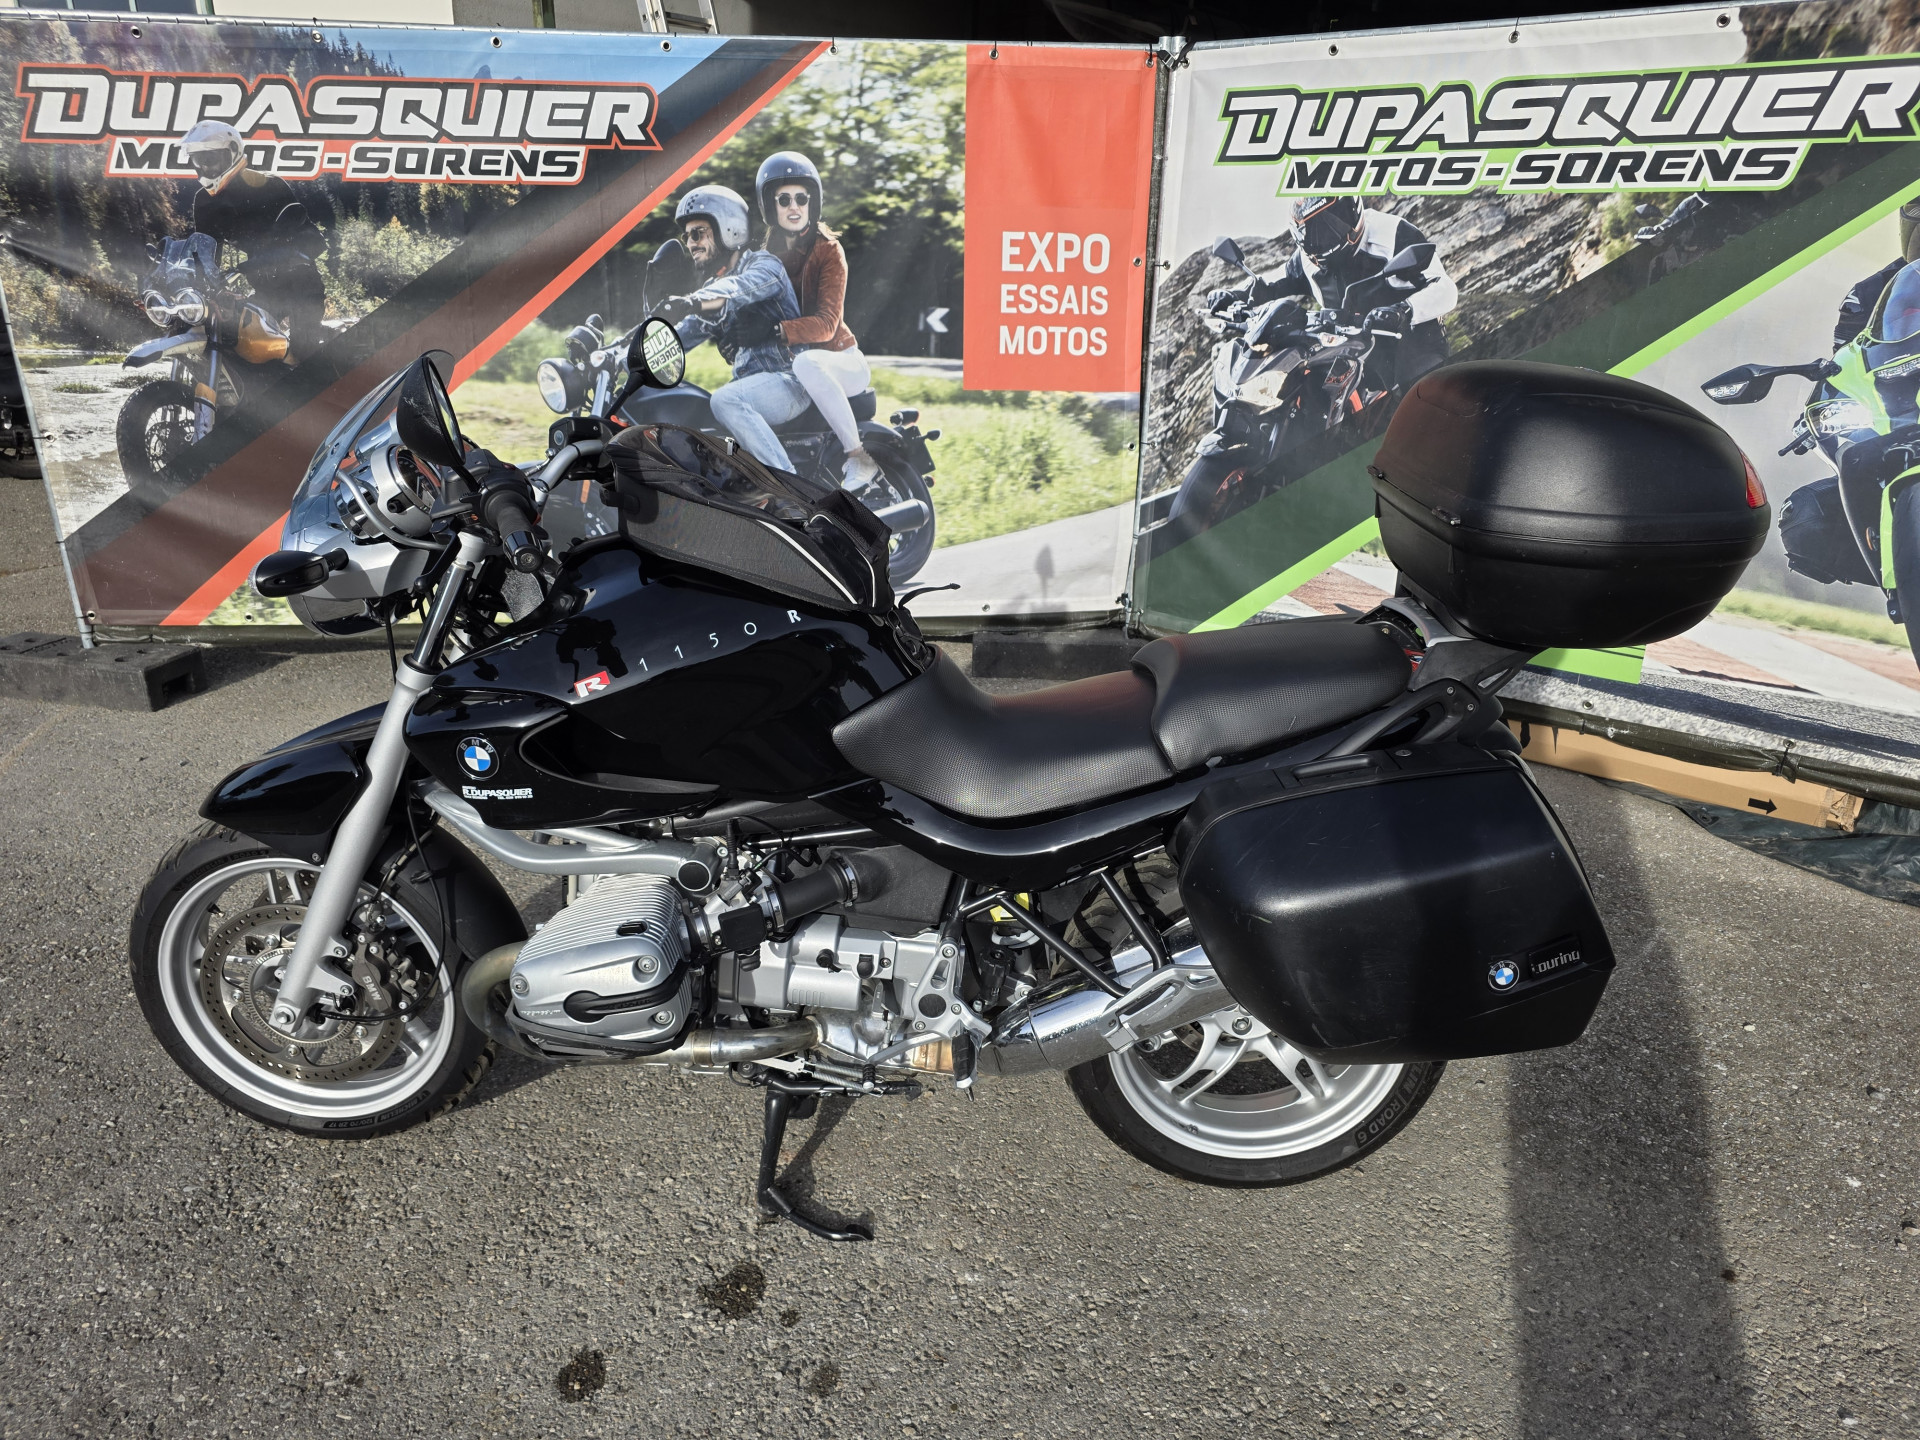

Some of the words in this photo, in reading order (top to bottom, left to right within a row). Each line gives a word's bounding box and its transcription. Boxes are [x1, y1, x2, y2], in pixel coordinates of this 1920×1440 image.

[28, 73, 647, 140] DUPASQUIER
[1226, 65, 1919, 156] DUPASQUIER
[1002, 231, 1111, 274] EXPO
[1000, 283, 1109, 316] ESSAIS
[999, 325, 1107, 356] MOTOS
[362, 975, 382, 1001] BMW
[1368, 1099, 1401, 1134] ROAD
[1357, 1131, 1368, 1144] 6
